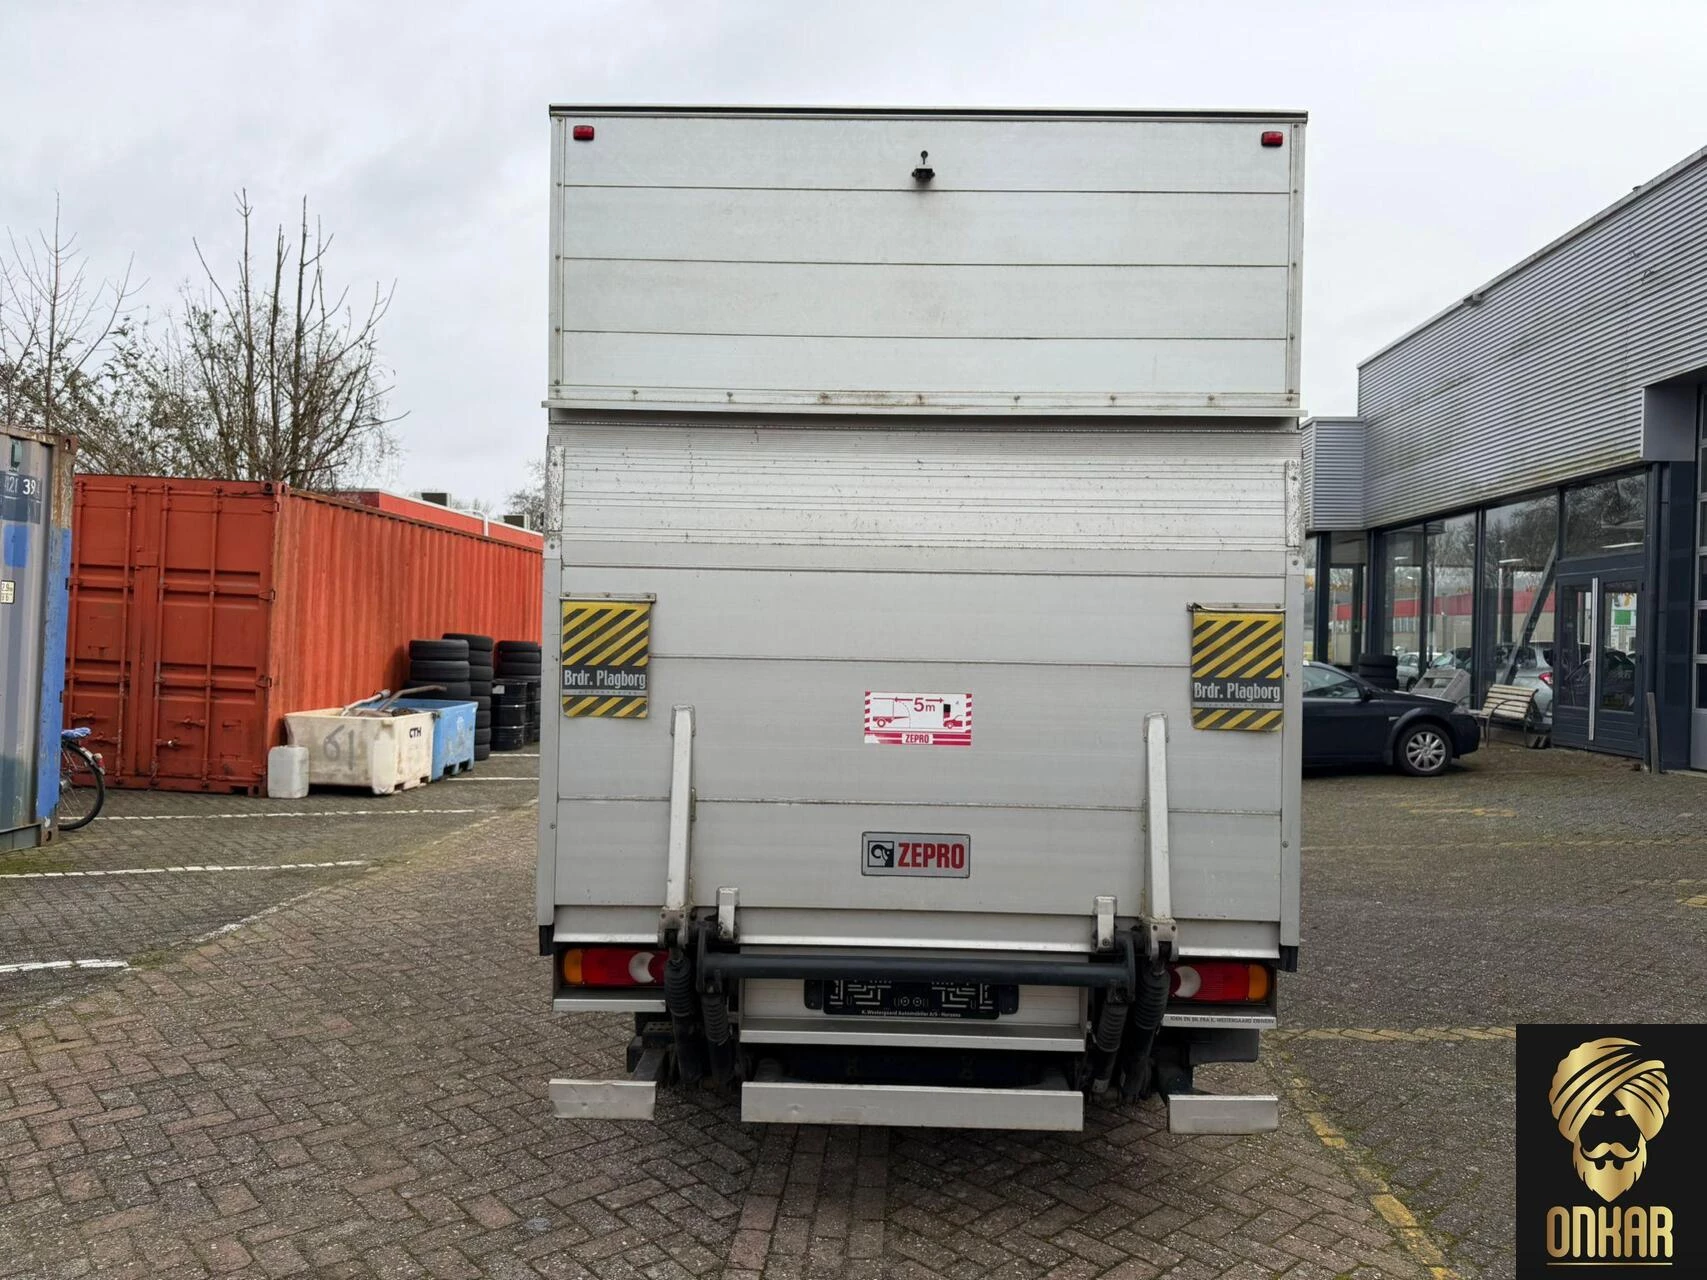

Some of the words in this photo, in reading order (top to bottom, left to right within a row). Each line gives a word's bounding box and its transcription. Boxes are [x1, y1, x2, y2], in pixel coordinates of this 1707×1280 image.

[564, 670, 593, 686] Brdr.
[596, 670, 646, 689] Plagborg
[1194, 682, 1223, 698] Brdr.
[1226, 682, 1281, 702] Plagborg
[905, 734, 930, 744] ZEPRO
[898, 842, 965, 869] ZEPRO
